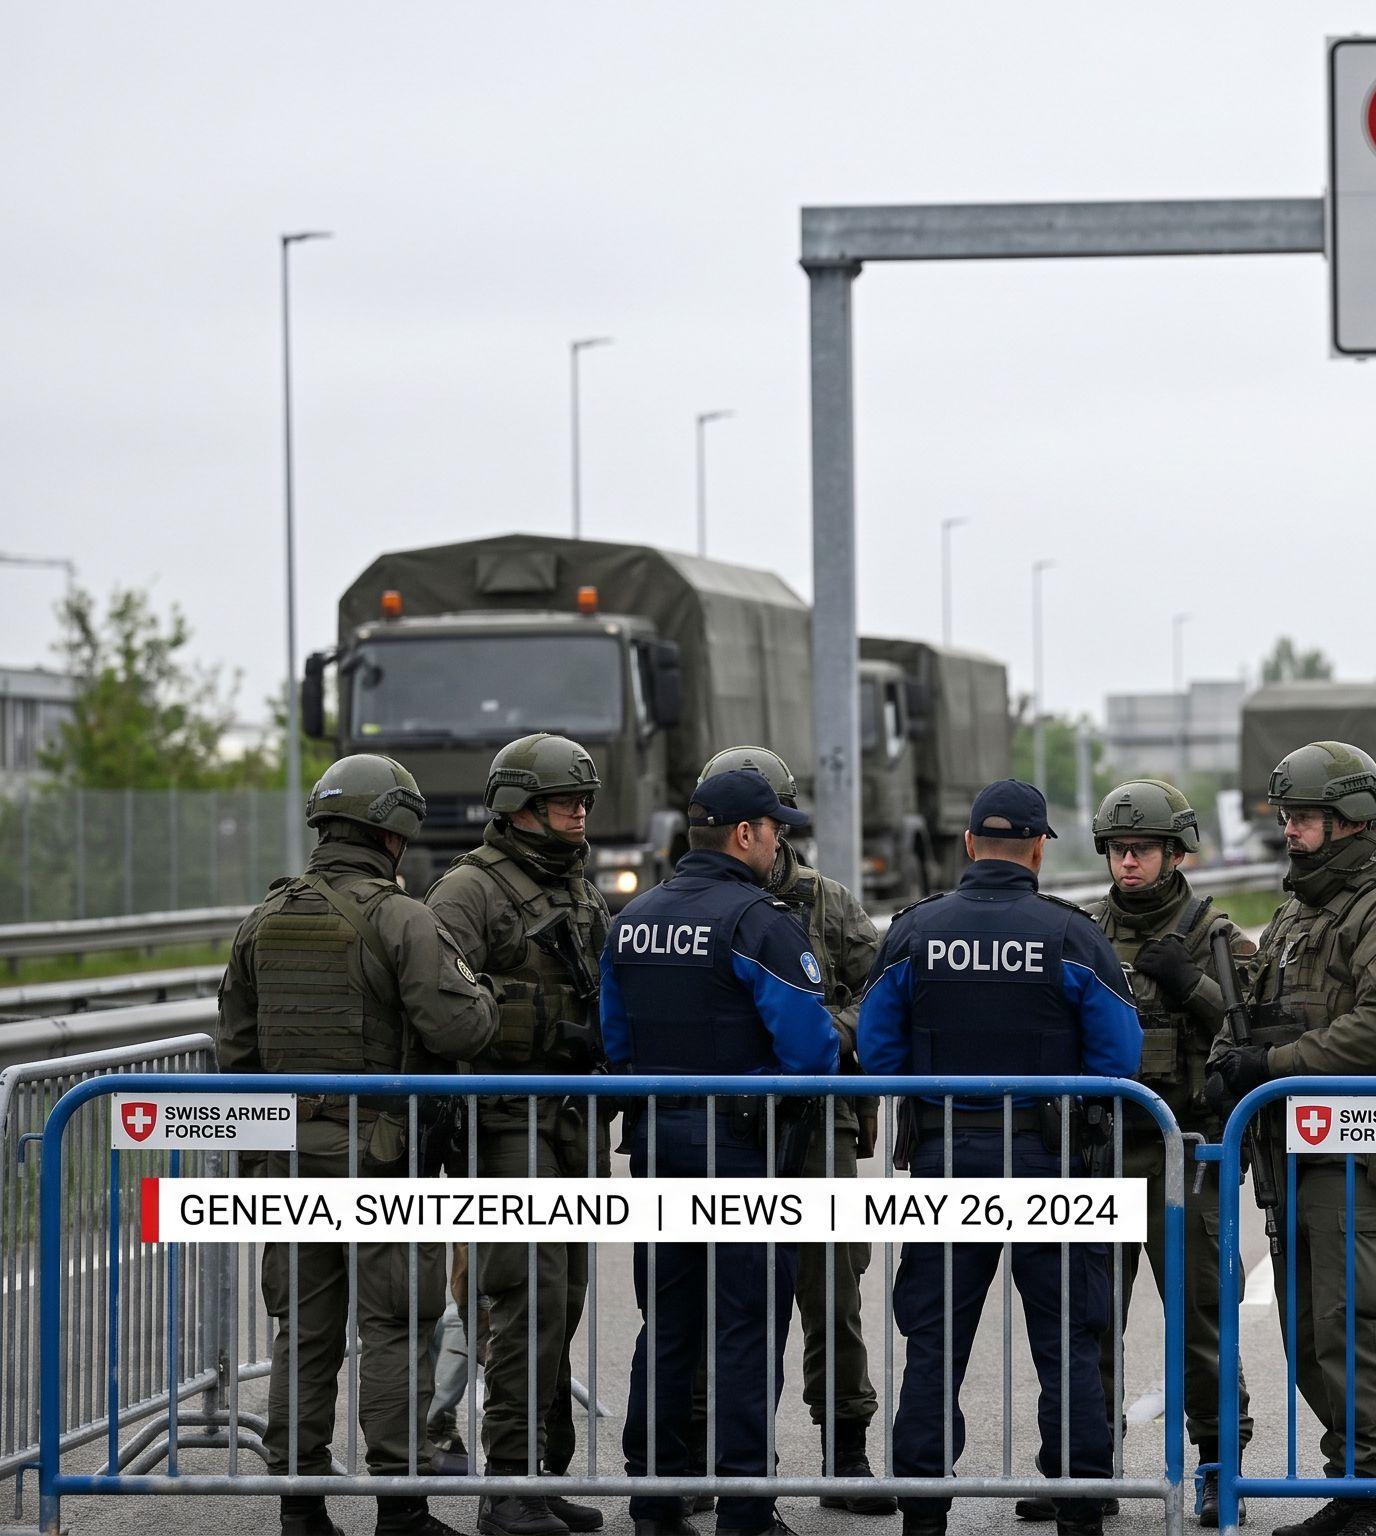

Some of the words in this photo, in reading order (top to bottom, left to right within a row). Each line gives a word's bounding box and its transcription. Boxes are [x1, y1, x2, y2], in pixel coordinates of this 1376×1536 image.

[617, 923, 712, 957] POLICE
[927, 939, 1044, 973] POLICE
[164, 1105, 221, 1121] SWISS
[225, 1106, 291, 1121] ARMED
[165, 1124, 237, 1139] FORCES
